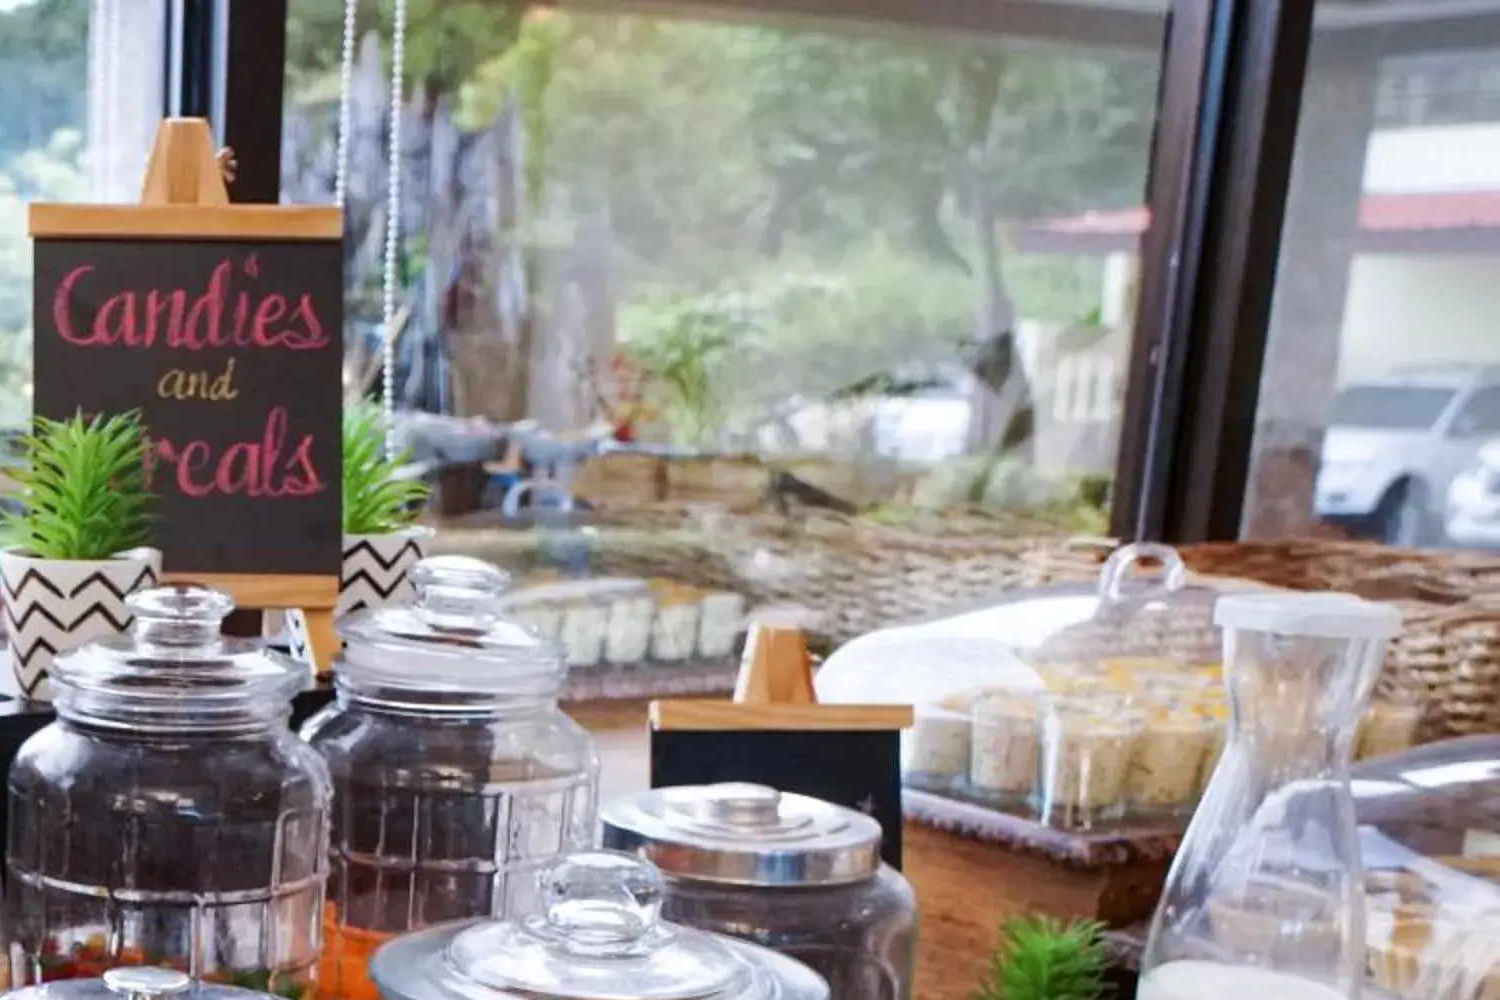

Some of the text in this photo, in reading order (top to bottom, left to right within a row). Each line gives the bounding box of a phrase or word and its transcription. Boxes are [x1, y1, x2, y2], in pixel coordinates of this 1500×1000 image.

[53, 252, 330, 350] Candies
[157, 357, 238, 400] and
[66, 406, 327, 497] reals
